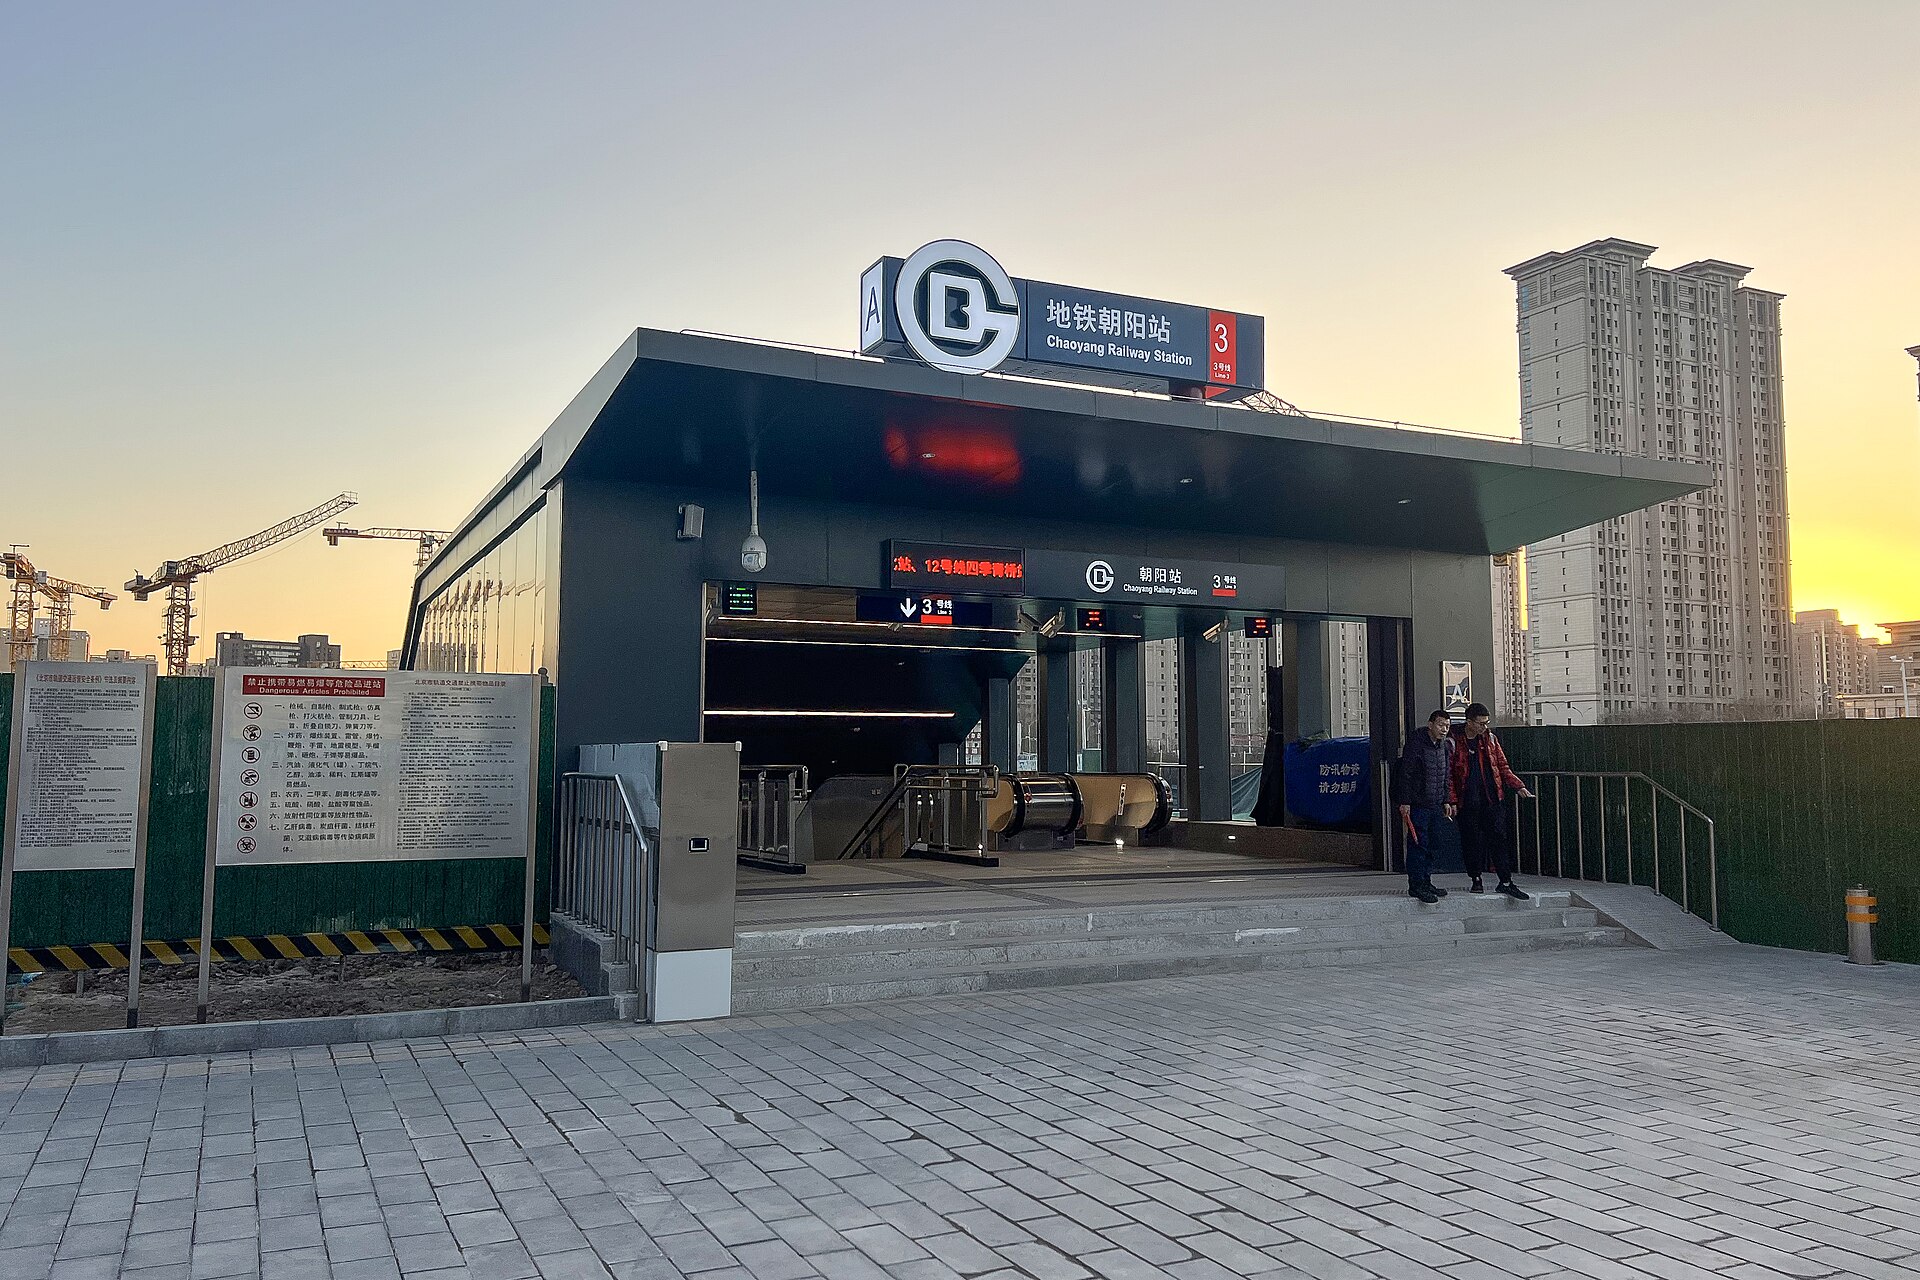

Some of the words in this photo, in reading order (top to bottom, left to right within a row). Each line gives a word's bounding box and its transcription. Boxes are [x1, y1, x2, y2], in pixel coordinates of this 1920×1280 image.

[865, 286, 880, 332] A
[1046, 298, 1171, 343] 地铁朝阳站
[1214, 323, 1229, 353] 3
[1046, 334, 1105, 357] Chaoyang
[1107, 342, 1151, 363] Railway
[1153, 349, 1192, 366] Station
[1213, 362, 1231, 373] 3号线
[1214, 371, 1225, 379] Line
[1139, 566, 1182, 584] 朝阳站
[1212, 574, 1221, 589] 3
[1223, 575, 1237, 585] 号线
[1123, 583, 1153, 595] Chaoyang
[1153, 585, 1176, 596] Railway
[1177, 586, 1198, 596] Station
[922, 598, 932, 614] 3
[936, 600, 952, 609] 号线
[248, 677, 381, 689] 禁止携带易燃易爆等危险品进站
[259, 687, 299, 695] Dangerous
[333, 688, 370, 696] Prohibited
[1453, 684, 1464, 703] A
[1319, 764, 1361, 777] 防汛物资
